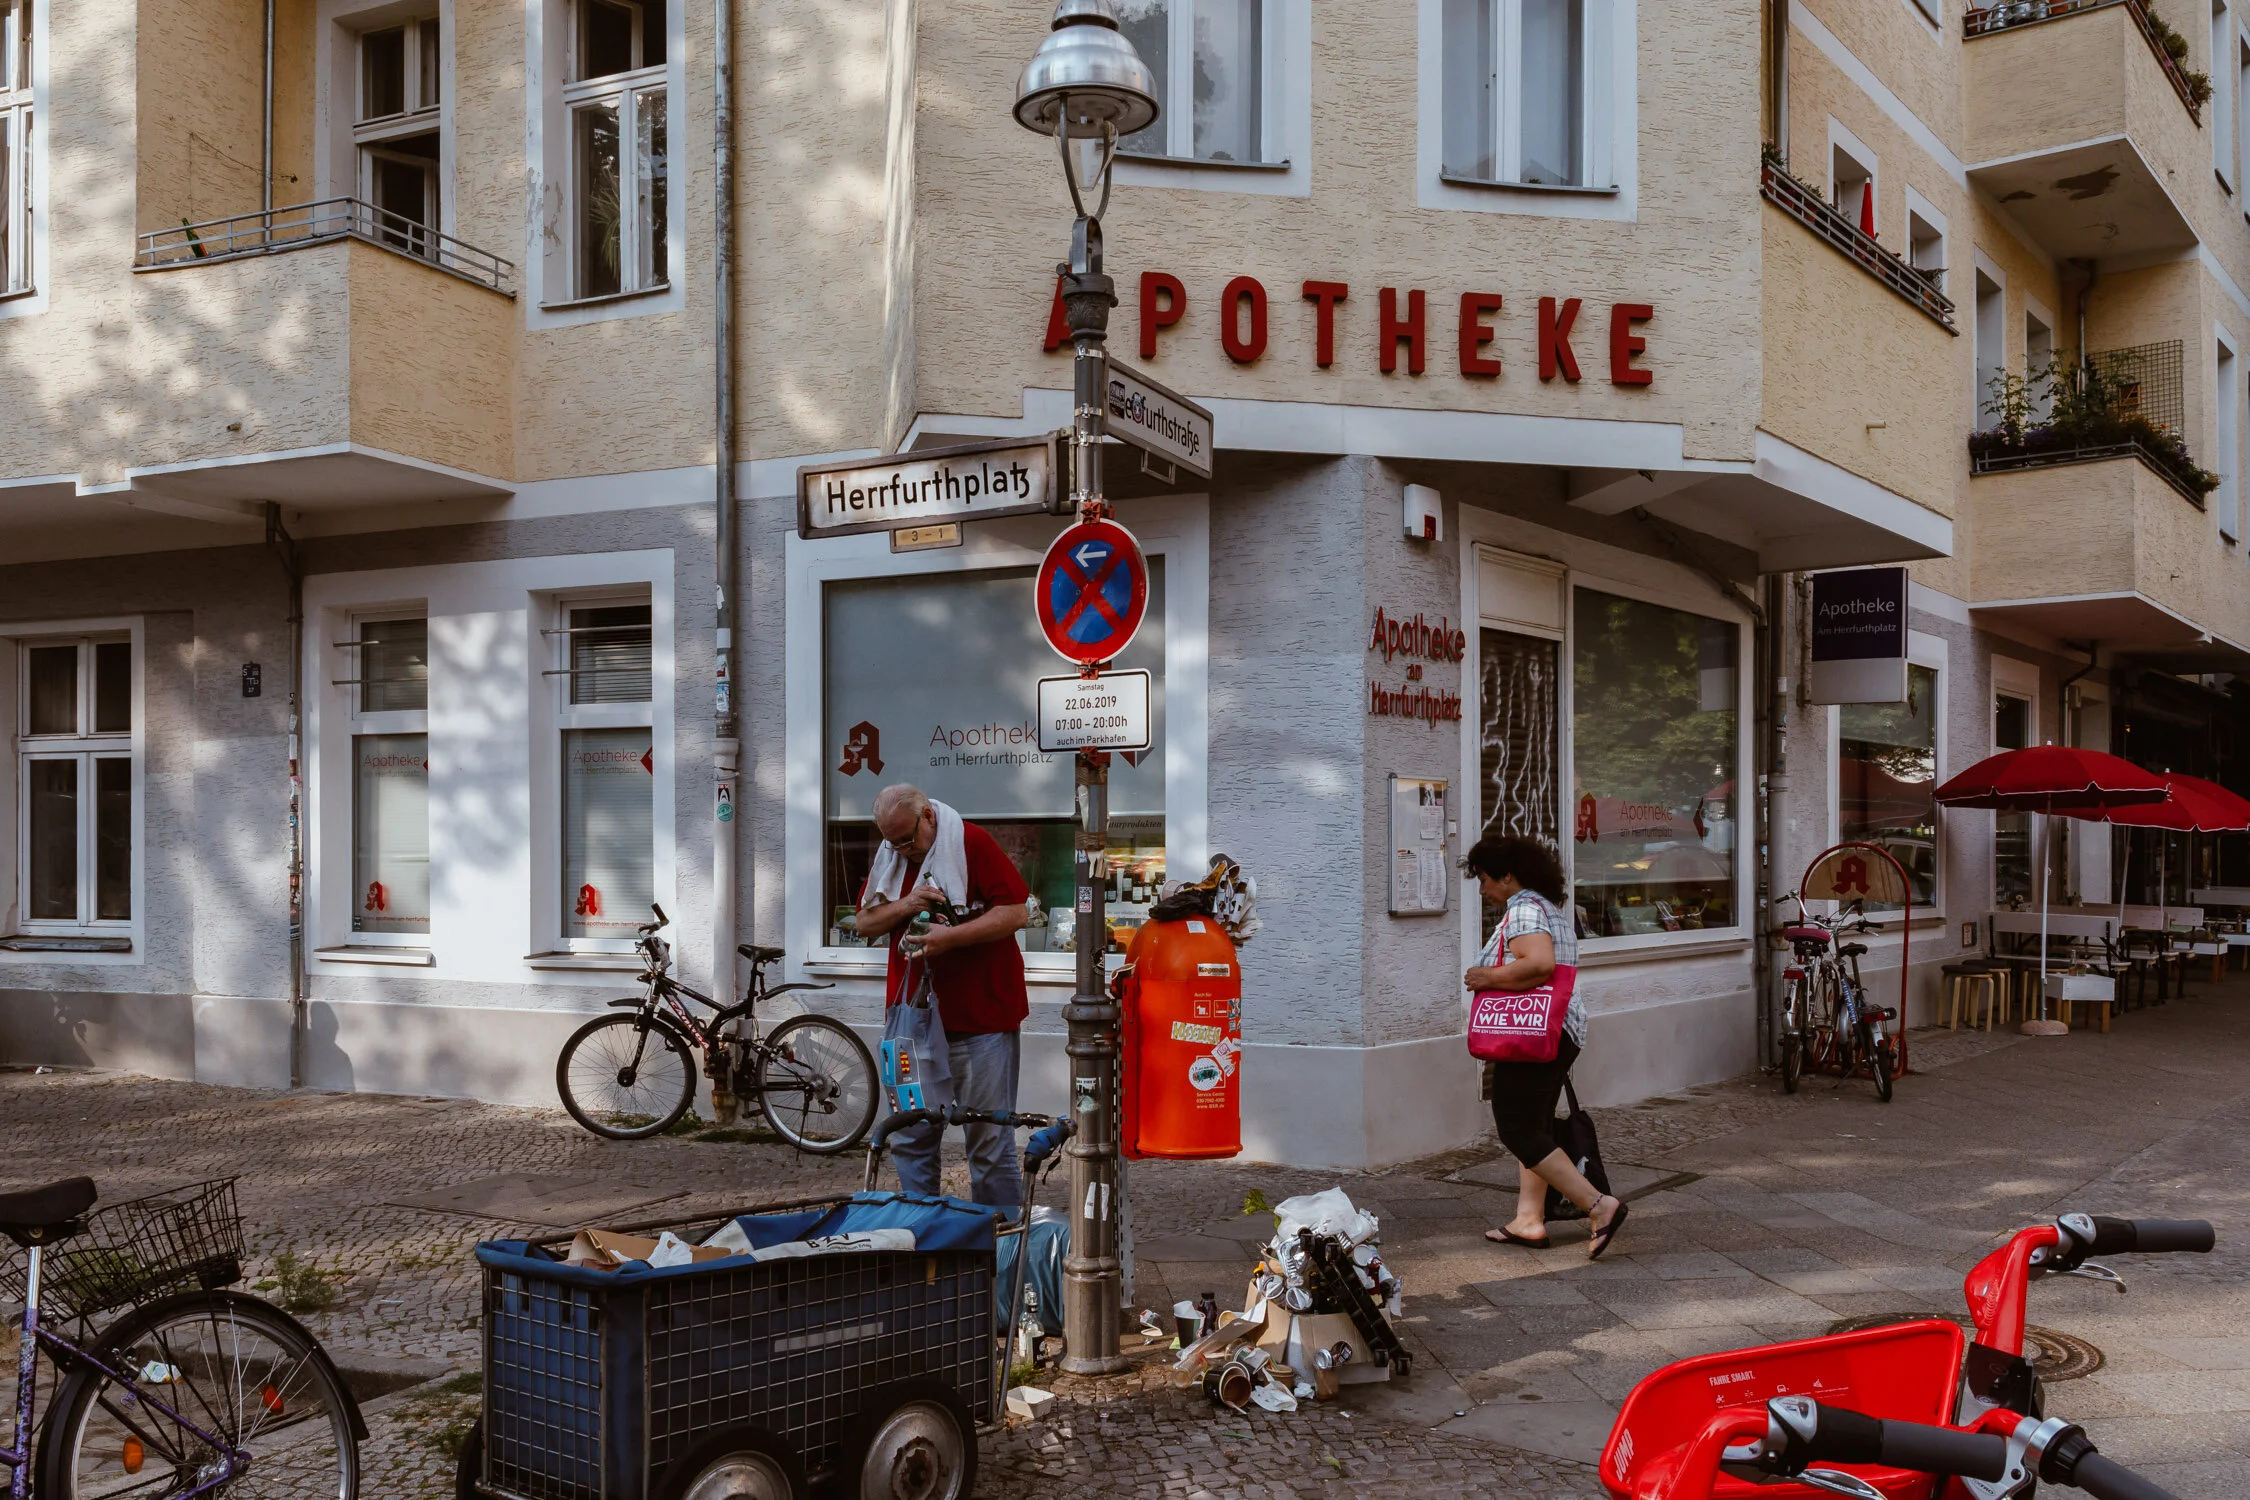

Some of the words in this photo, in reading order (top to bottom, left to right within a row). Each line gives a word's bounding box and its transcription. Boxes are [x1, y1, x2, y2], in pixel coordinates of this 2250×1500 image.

[827, 462, 1030, 513] Herrfurthplatz
[911, 531, 919, 541] 3
[938, 528, 943, 539] 1
[1819, 597, 1895, 620] Apotheke
[1370, 606, 1465, 662] Apotheke
[1833, 623, 1897, 635] Herrfurthplatz
[1408, 664, 1423, 680] am
[1077, 684, 1104, 692] Samstag
[1065, 696, 1117, 710] 22.06.2019
[1370, 681, 1462, 727] Herrfurthplatz
[1055, 718, 1082, 730] 07:00
[1093, 716, 1128, 728] 20:00h
[929, 720, 1037, 749] Apothek
[1056, 737, 1075, 745] auch
[1087, 734, 1127, 744] Parkhafen
[364, 754, 420, 768] Apotheke
[573, 748, 637, 764] Apotheke
[929, 755, 950, 767] am
[587, 766, 638, 775] Herrfurthplatz
[1620, 800, 1673, 821] Apotheke
[1620, 829, 1629, 837] am
[1632, 827, 1673, 838] Herrfurthplatz
[1481, 994, 1547, 1012] SCHÖN
[1479, 1013, 1508, 1026] WIE
[1513, 1013, 1543, 1027] WIR
[1709, 1375, 1731, 1387] FAHRE
[1731, 1370, 1756, 1383] SMART.
[1613, 1428, 1635, 1482] JUMP
